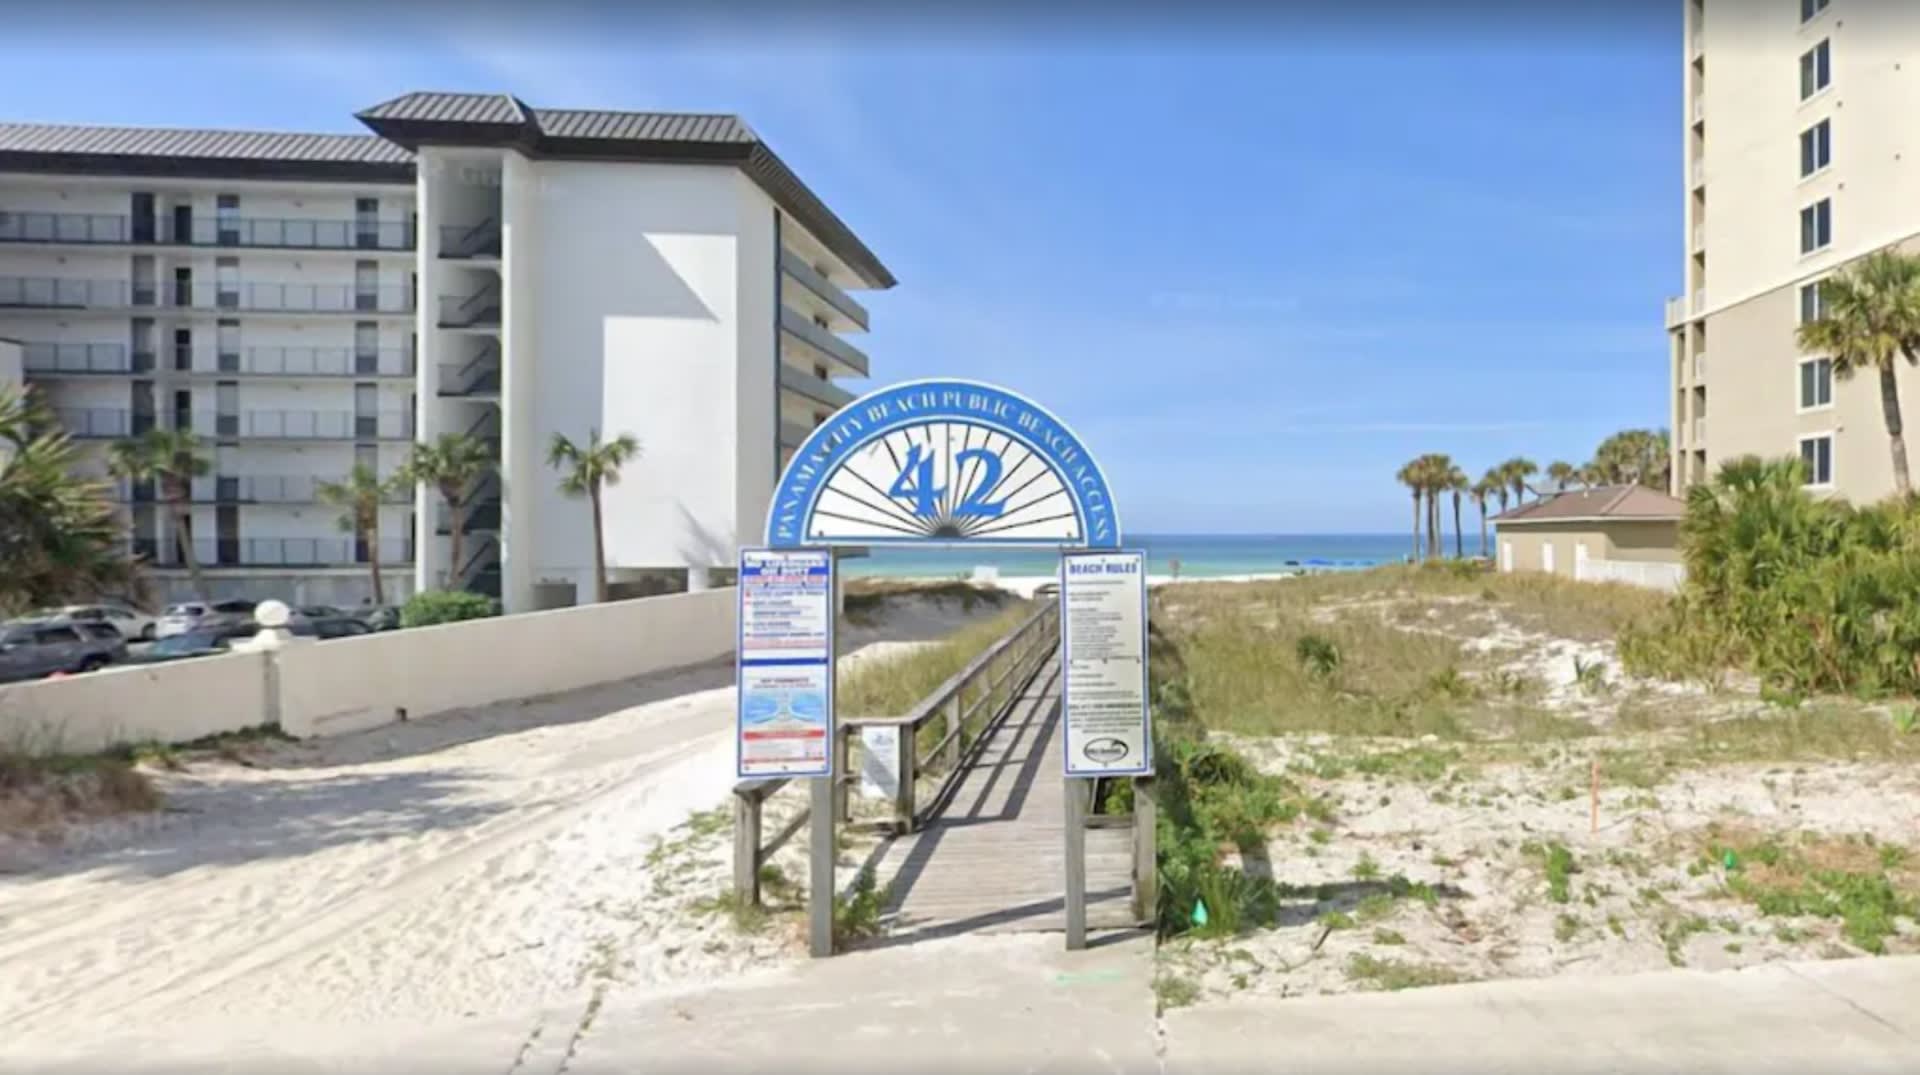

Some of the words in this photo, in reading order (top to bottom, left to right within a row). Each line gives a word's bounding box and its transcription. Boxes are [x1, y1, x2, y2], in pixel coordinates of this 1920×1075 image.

[777, 455, 825, 538] PANAMA
[821, 417, 863, 454] CITY
[867, 389, 937, 421] BEACH
[944, 390, 1012, 420] PUBLIC
[1017, 411, 1078, 464] BEACH
[1071, 465, 1111, 541] ACCESS
[888, 440, 1009, 517] 42
[1069, 564, 1103, 574] BEACH
[1106, 563, 1137, 574] RULES
